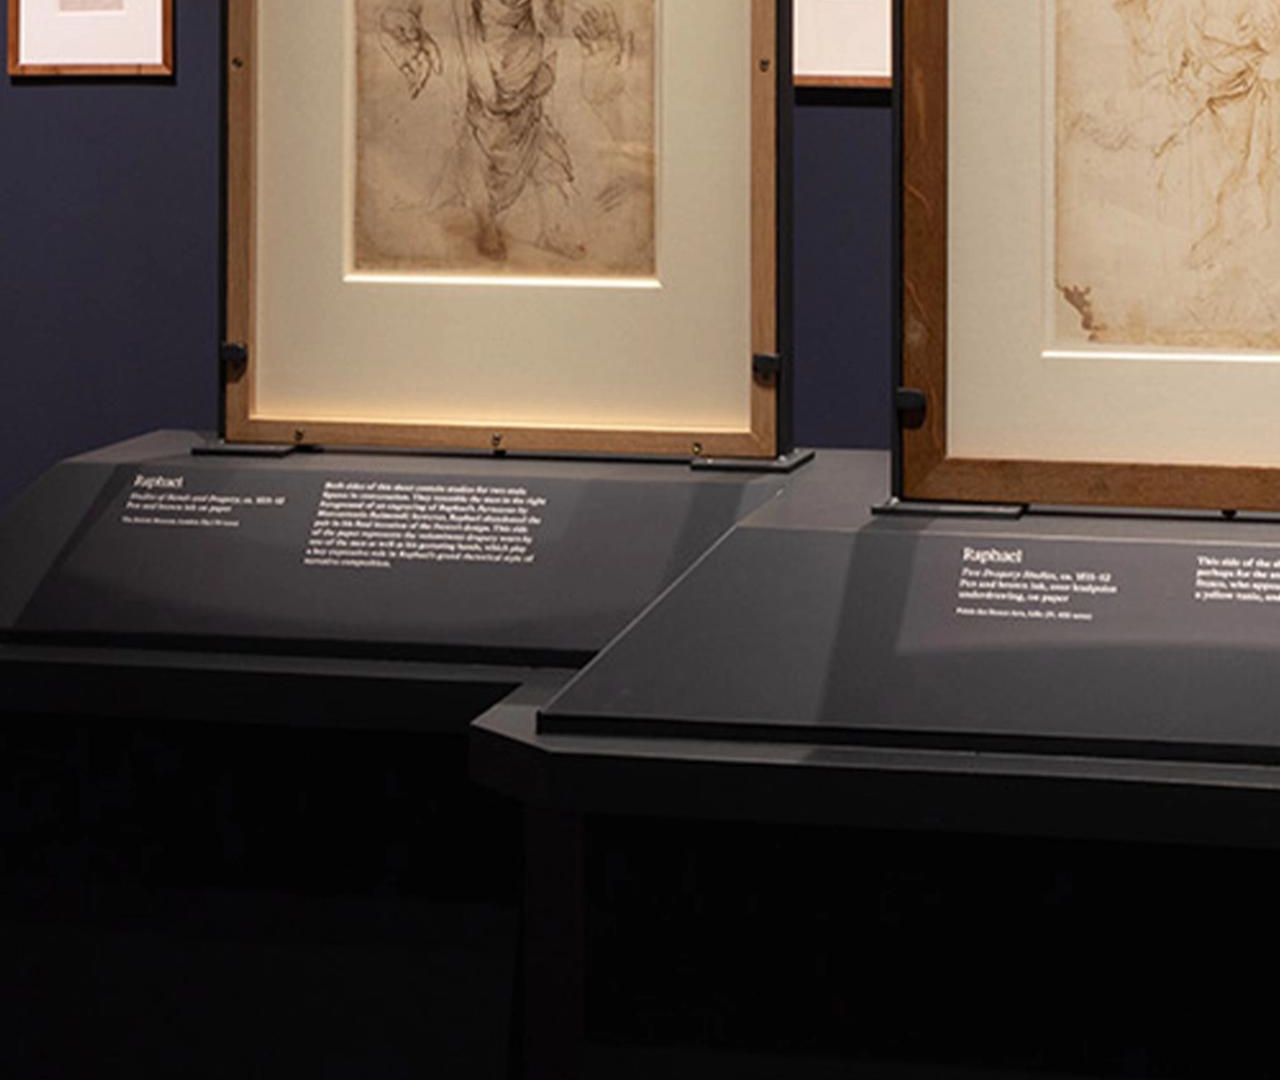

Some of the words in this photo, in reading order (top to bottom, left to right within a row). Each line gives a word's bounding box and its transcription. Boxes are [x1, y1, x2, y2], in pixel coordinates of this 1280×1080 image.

[134, 475, 184, 489] Raphael
[963, 546, 1022, 564] Raphael
[1197, 556, 1218, 566] This
[960, 578, 976, 588] Pen
[979, 581, 995, 589] and
[1041, 595, 1069, 603] paper
